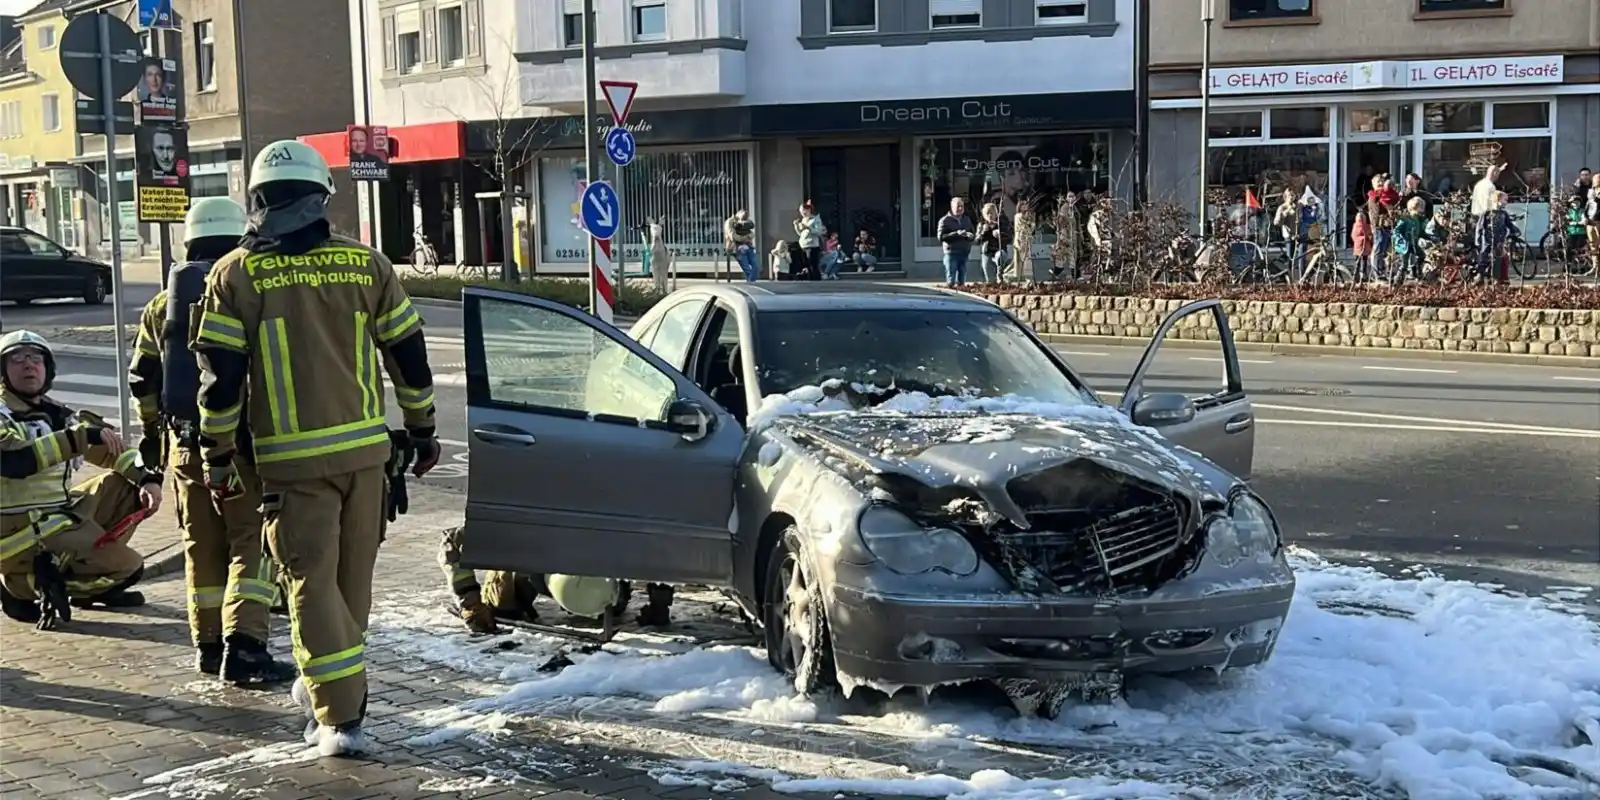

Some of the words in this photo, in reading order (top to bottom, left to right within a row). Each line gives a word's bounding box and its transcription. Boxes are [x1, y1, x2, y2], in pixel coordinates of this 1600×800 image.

[1227, 72, 1289, 88] GELATO
[1295, 71, 1348, 86] Eiscafé
[1411, 68, 1427, 82] IL
[1434, 64, 1497, 81] GELATO
[1504, 63, 1558, 78] Eiscafé
[860, 104, 950, 122] Dream
[961, 101, 1011, 118] Cut
[351, 161, 376, 169] FRANK
[965, 158, 1022, 170] Dream
[1028, 156, 1060, 168] Cut
[351, 168, 388, 176] SCHWABE
[648, 168, 733, 194] Nagelstudio
[142, 188, 164, 196] Vater
[154, 196, 173, 204] nicht
[245, 250, 371, 276] Feuerwehr
[252, 269, 373, 294] Recklinghausen
